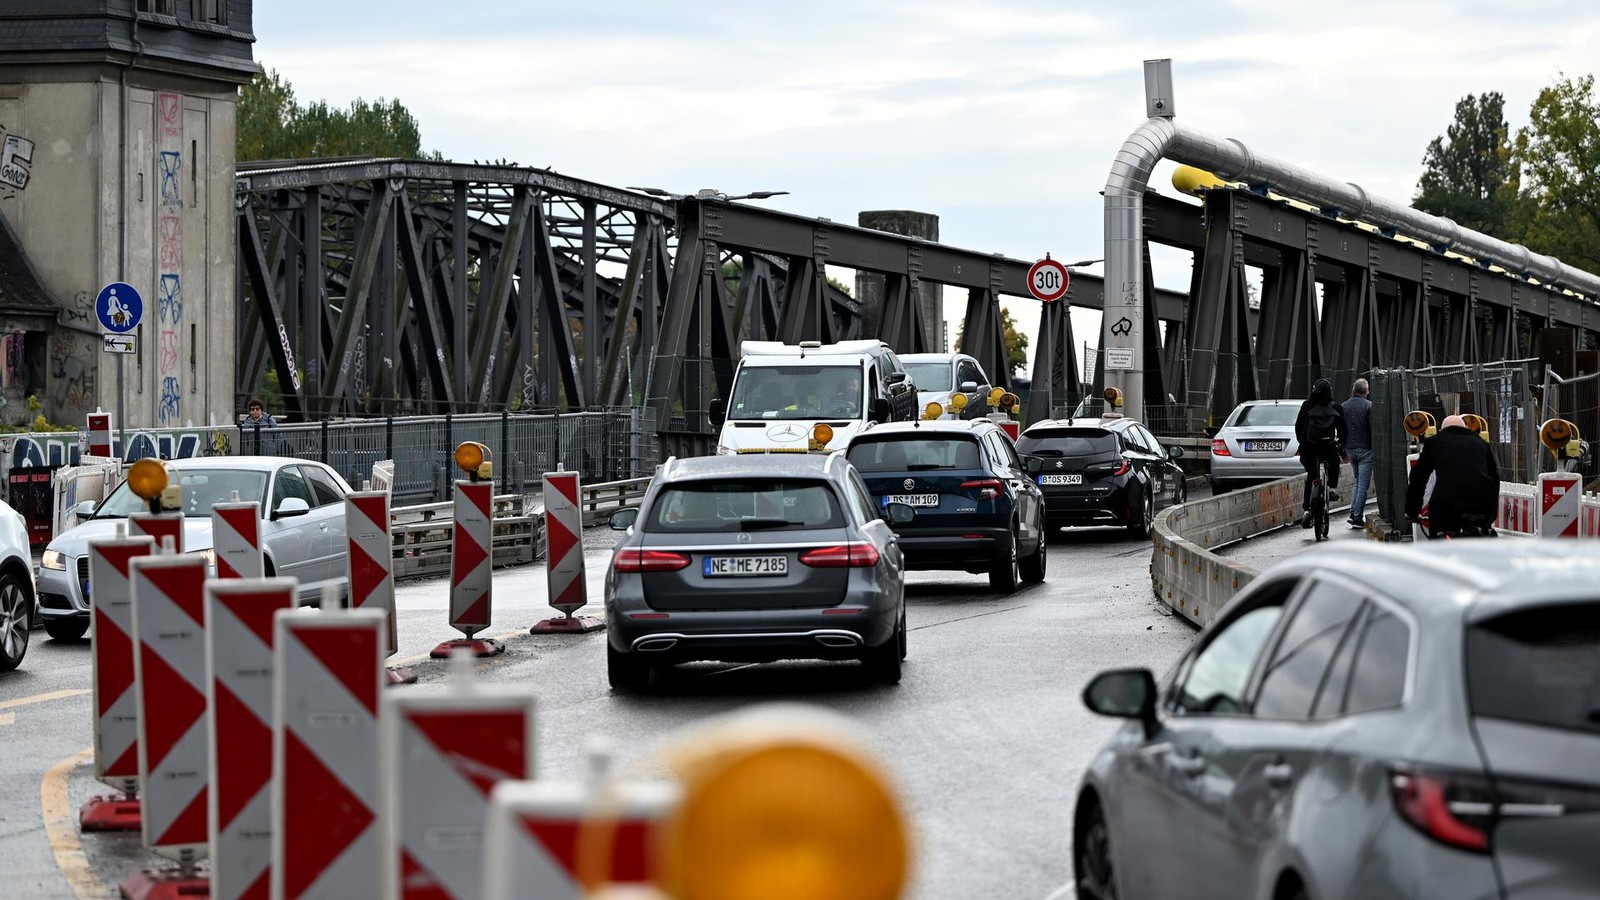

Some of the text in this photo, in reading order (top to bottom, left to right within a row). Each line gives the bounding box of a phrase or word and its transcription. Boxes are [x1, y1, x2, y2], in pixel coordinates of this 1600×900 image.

[1036, 271, 1060, 289] 30t
[1062, 475, 1081, 483] 9349
[910, 495, 921, 505] AM
[922, 495, 938, 504] 109
[712, 558, 786, 572] NE ME 7185
